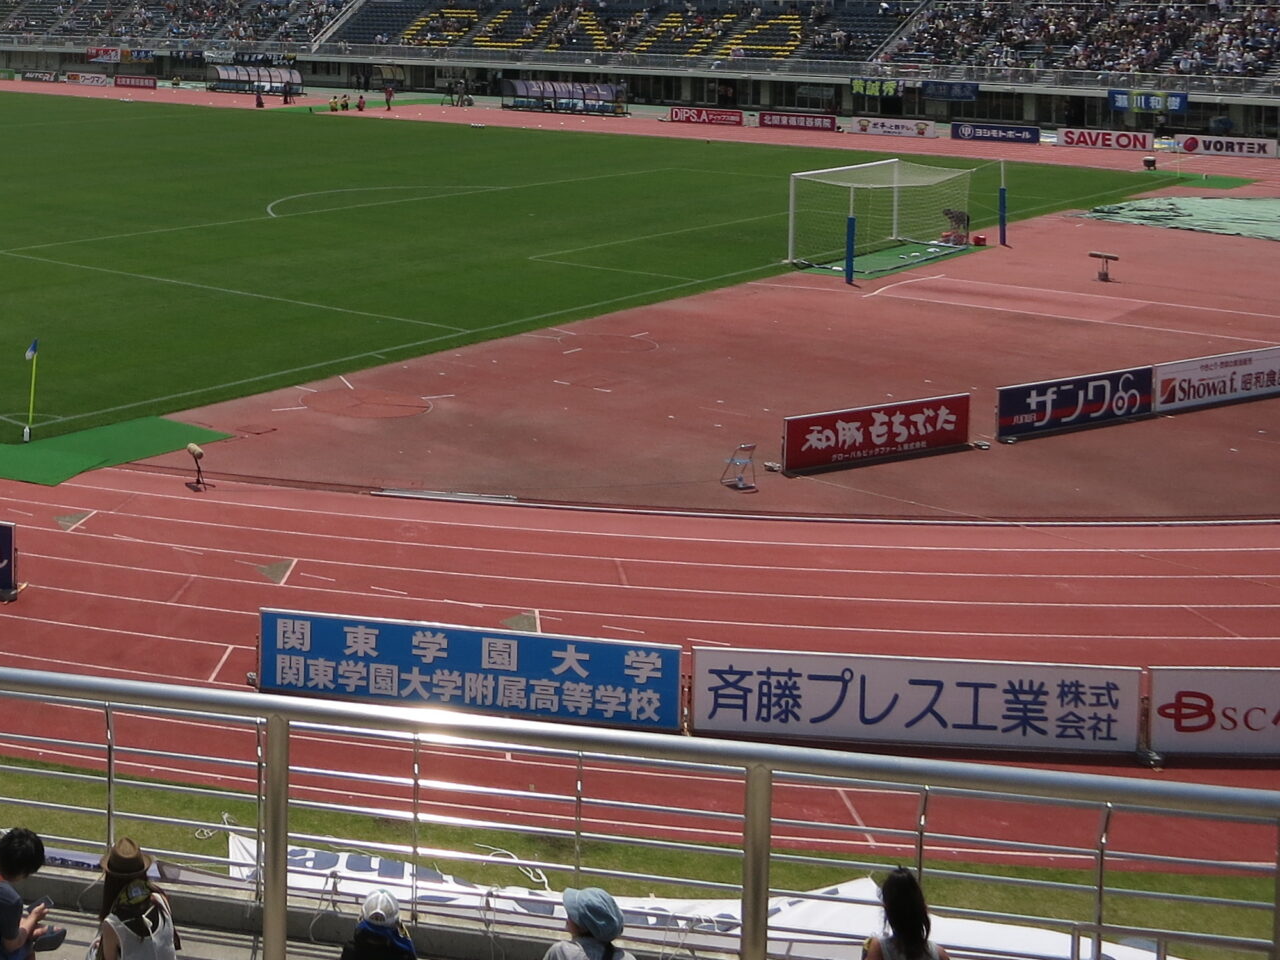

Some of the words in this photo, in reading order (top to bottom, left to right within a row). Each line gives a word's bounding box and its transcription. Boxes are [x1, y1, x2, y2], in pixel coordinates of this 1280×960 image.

[80, 75, 106, 84] ワークマン
[1114, 94, 1181, 111] 瀬川和樹
[763, 114, 832, 129] 北関東循環器病院
[1063, 130, 1112, 148] SAVE
[1115, 133, 1147, 149] ON
[1202, 139, 1268, 155] VORTEX
[276, 617, 663, 684] 関東学園大学
[275, 653, 662, 722] 関東学園大学附属高等学校
[706, 664, 1050, 737] 斉藤プレス工業
[1056, 677, 1120, 709] 株式
[1054, 711, 1119, 741] 会社
